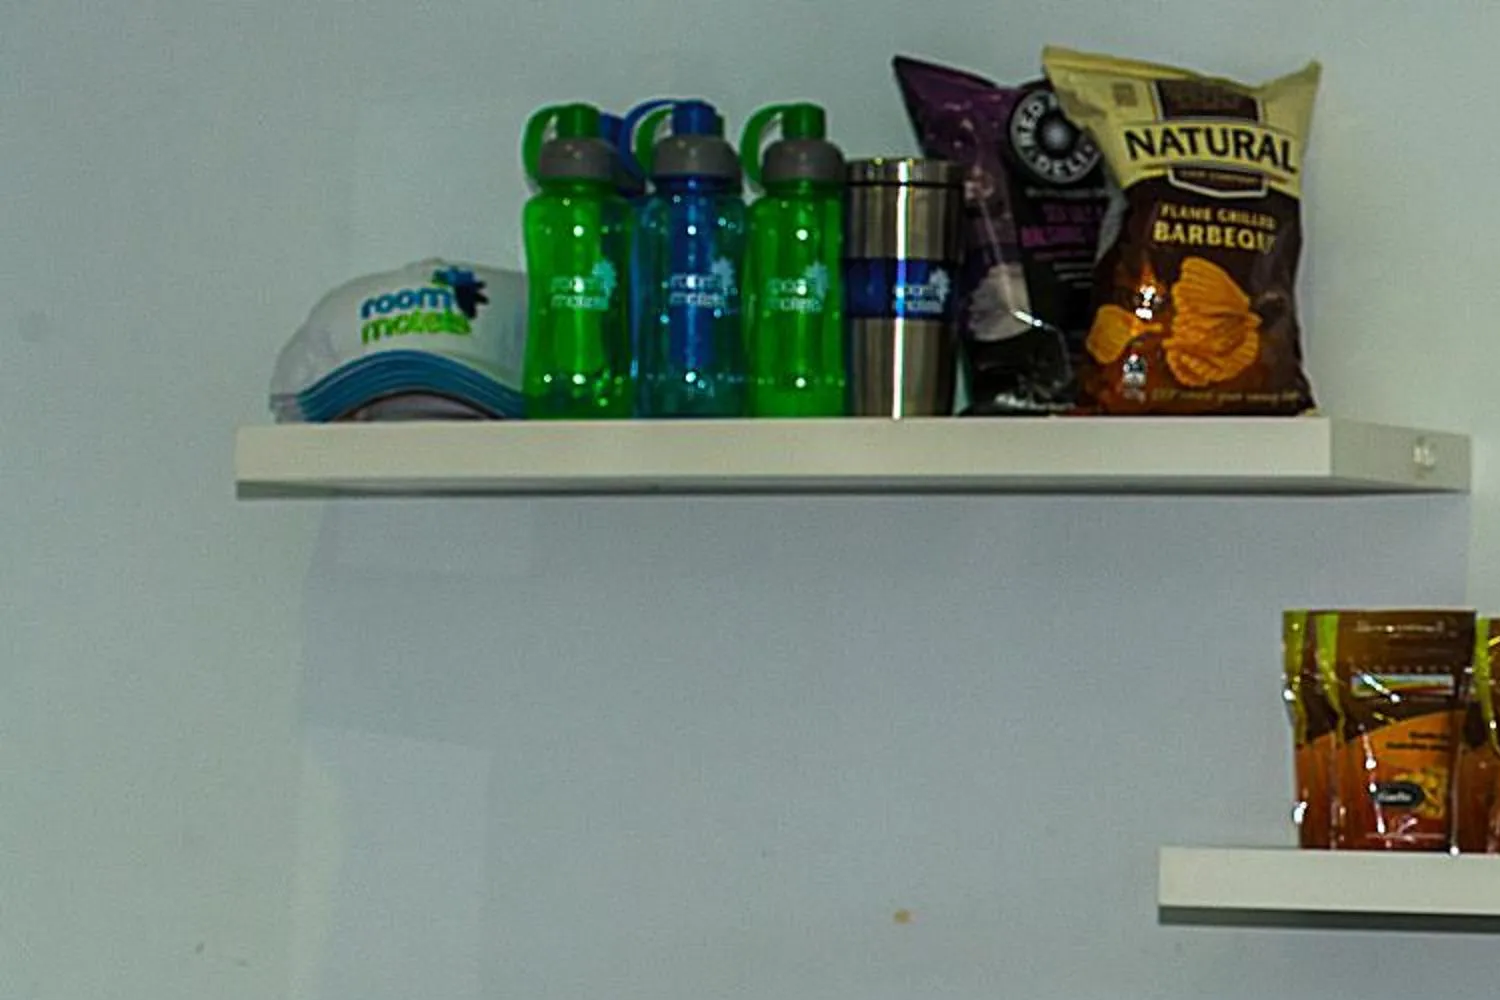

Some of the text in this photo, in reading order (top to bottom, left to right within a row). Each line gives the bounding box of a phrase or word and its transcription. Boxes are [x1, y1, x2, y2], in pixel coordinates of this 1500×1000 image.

[1124, 127, 1297, 174] NATURAL
[360, 287, 454, 319] room
[361, 310, 471, 345] motels
